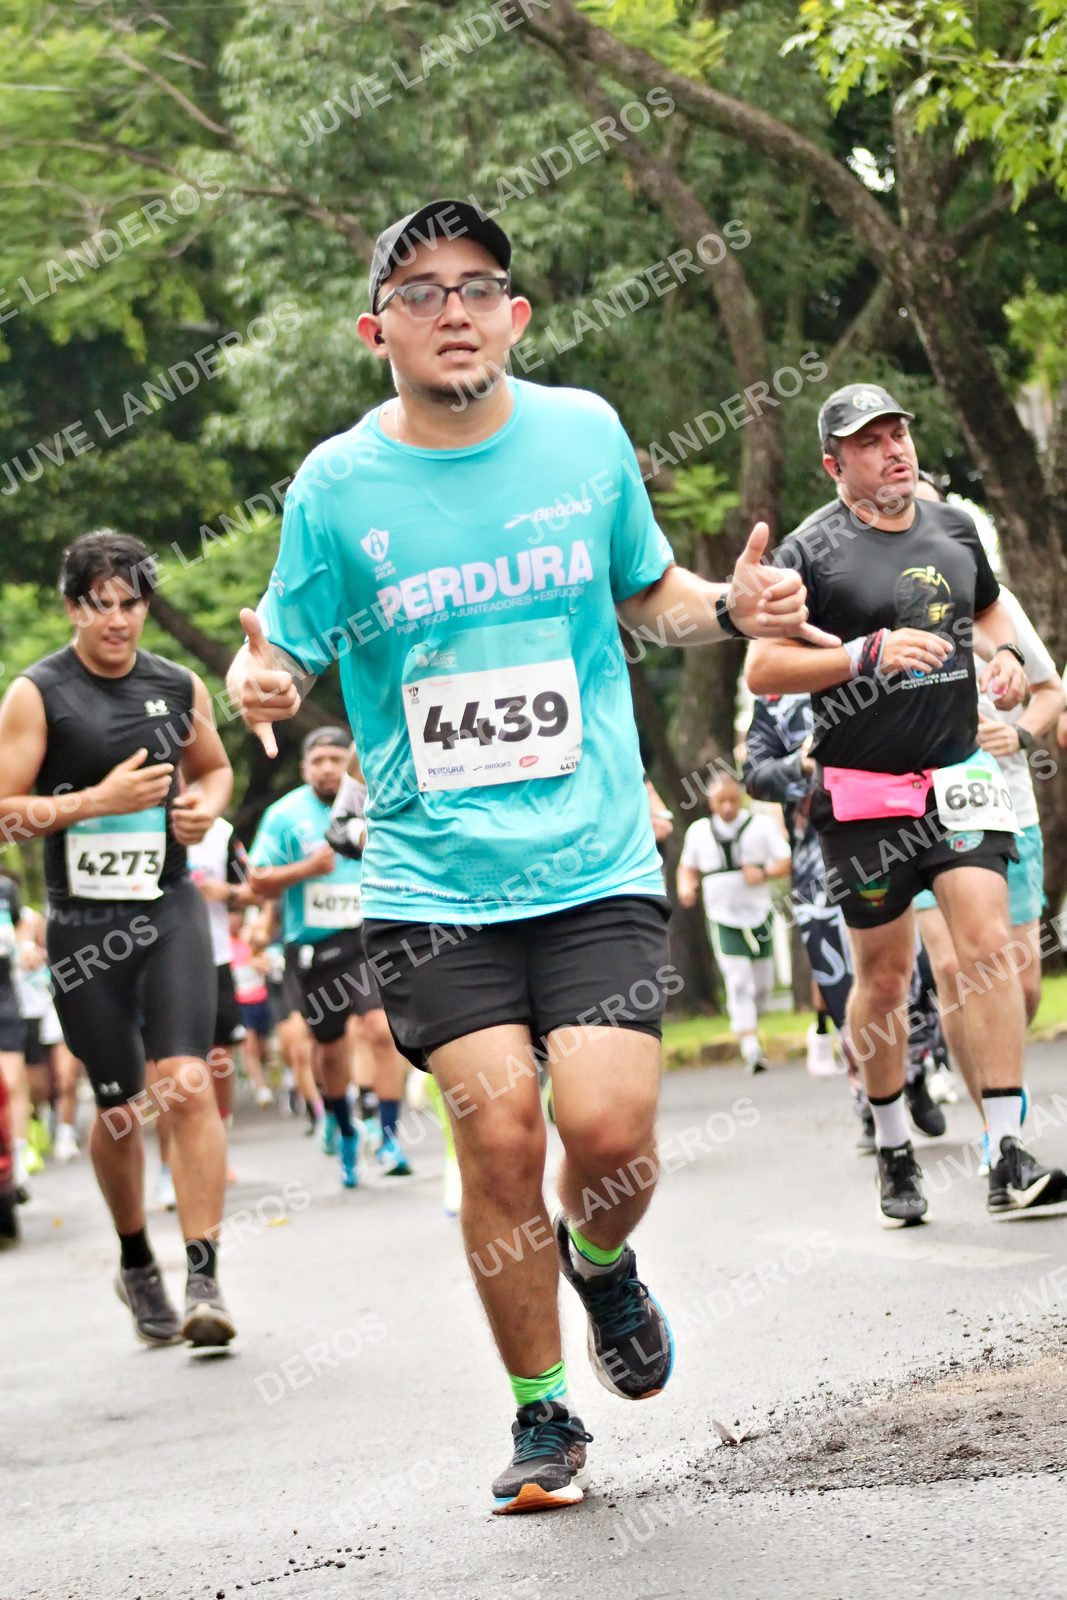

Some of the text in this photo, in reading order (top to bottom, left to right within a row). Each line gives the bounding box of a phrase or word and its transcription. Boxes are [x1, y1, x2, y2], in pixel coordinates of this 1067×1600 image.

[533, 499, 592, 522] BROOKS
[376, 540, 594, 627] PERDURA
[456, 594, 533, 618] JUNTEADORES
[423, 691, 569, 751] 4439
[77, 850, 161, 877] 4273
